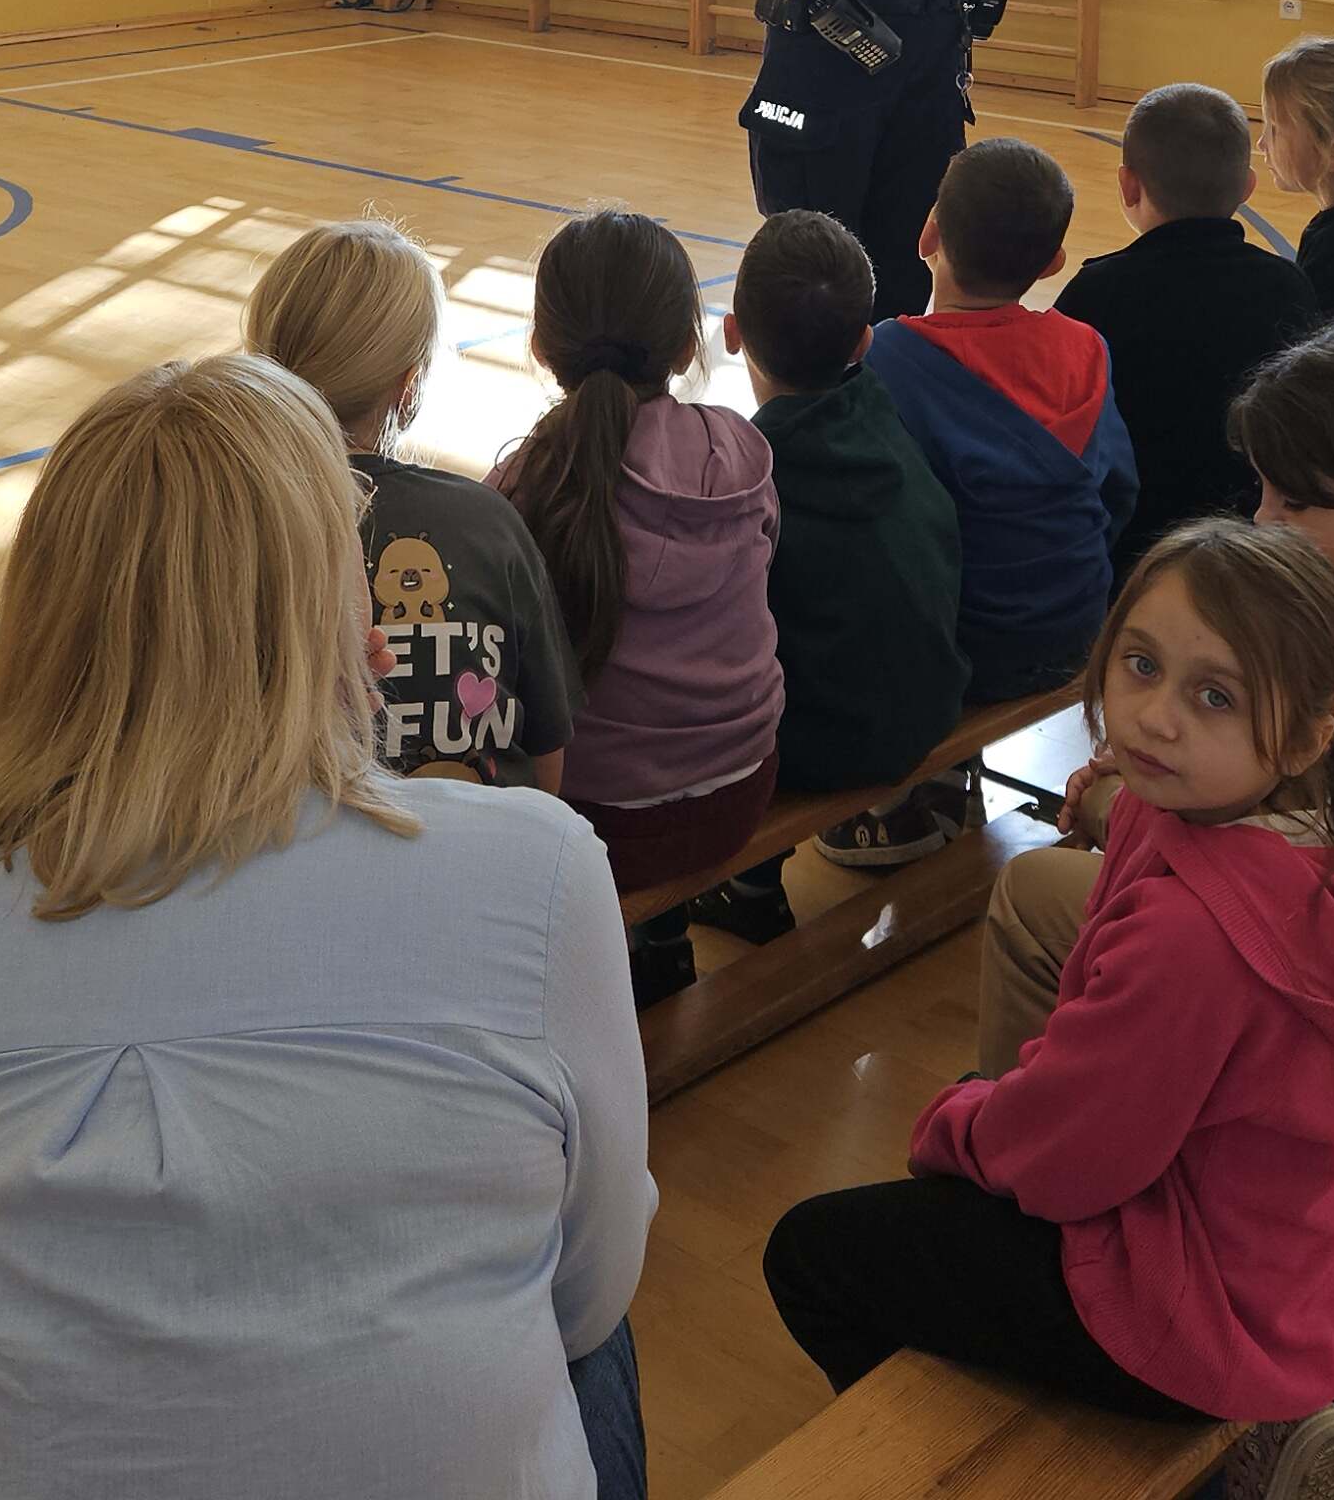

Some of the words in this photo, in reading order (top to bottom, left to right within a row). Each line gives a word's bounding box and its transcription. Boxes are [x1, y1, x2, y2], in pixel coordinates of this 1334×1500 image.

[754, 100, 805, 131] POLICJA
[373, 622, 505, 678] ET'S
[385, 698, 516, 758] FUN
